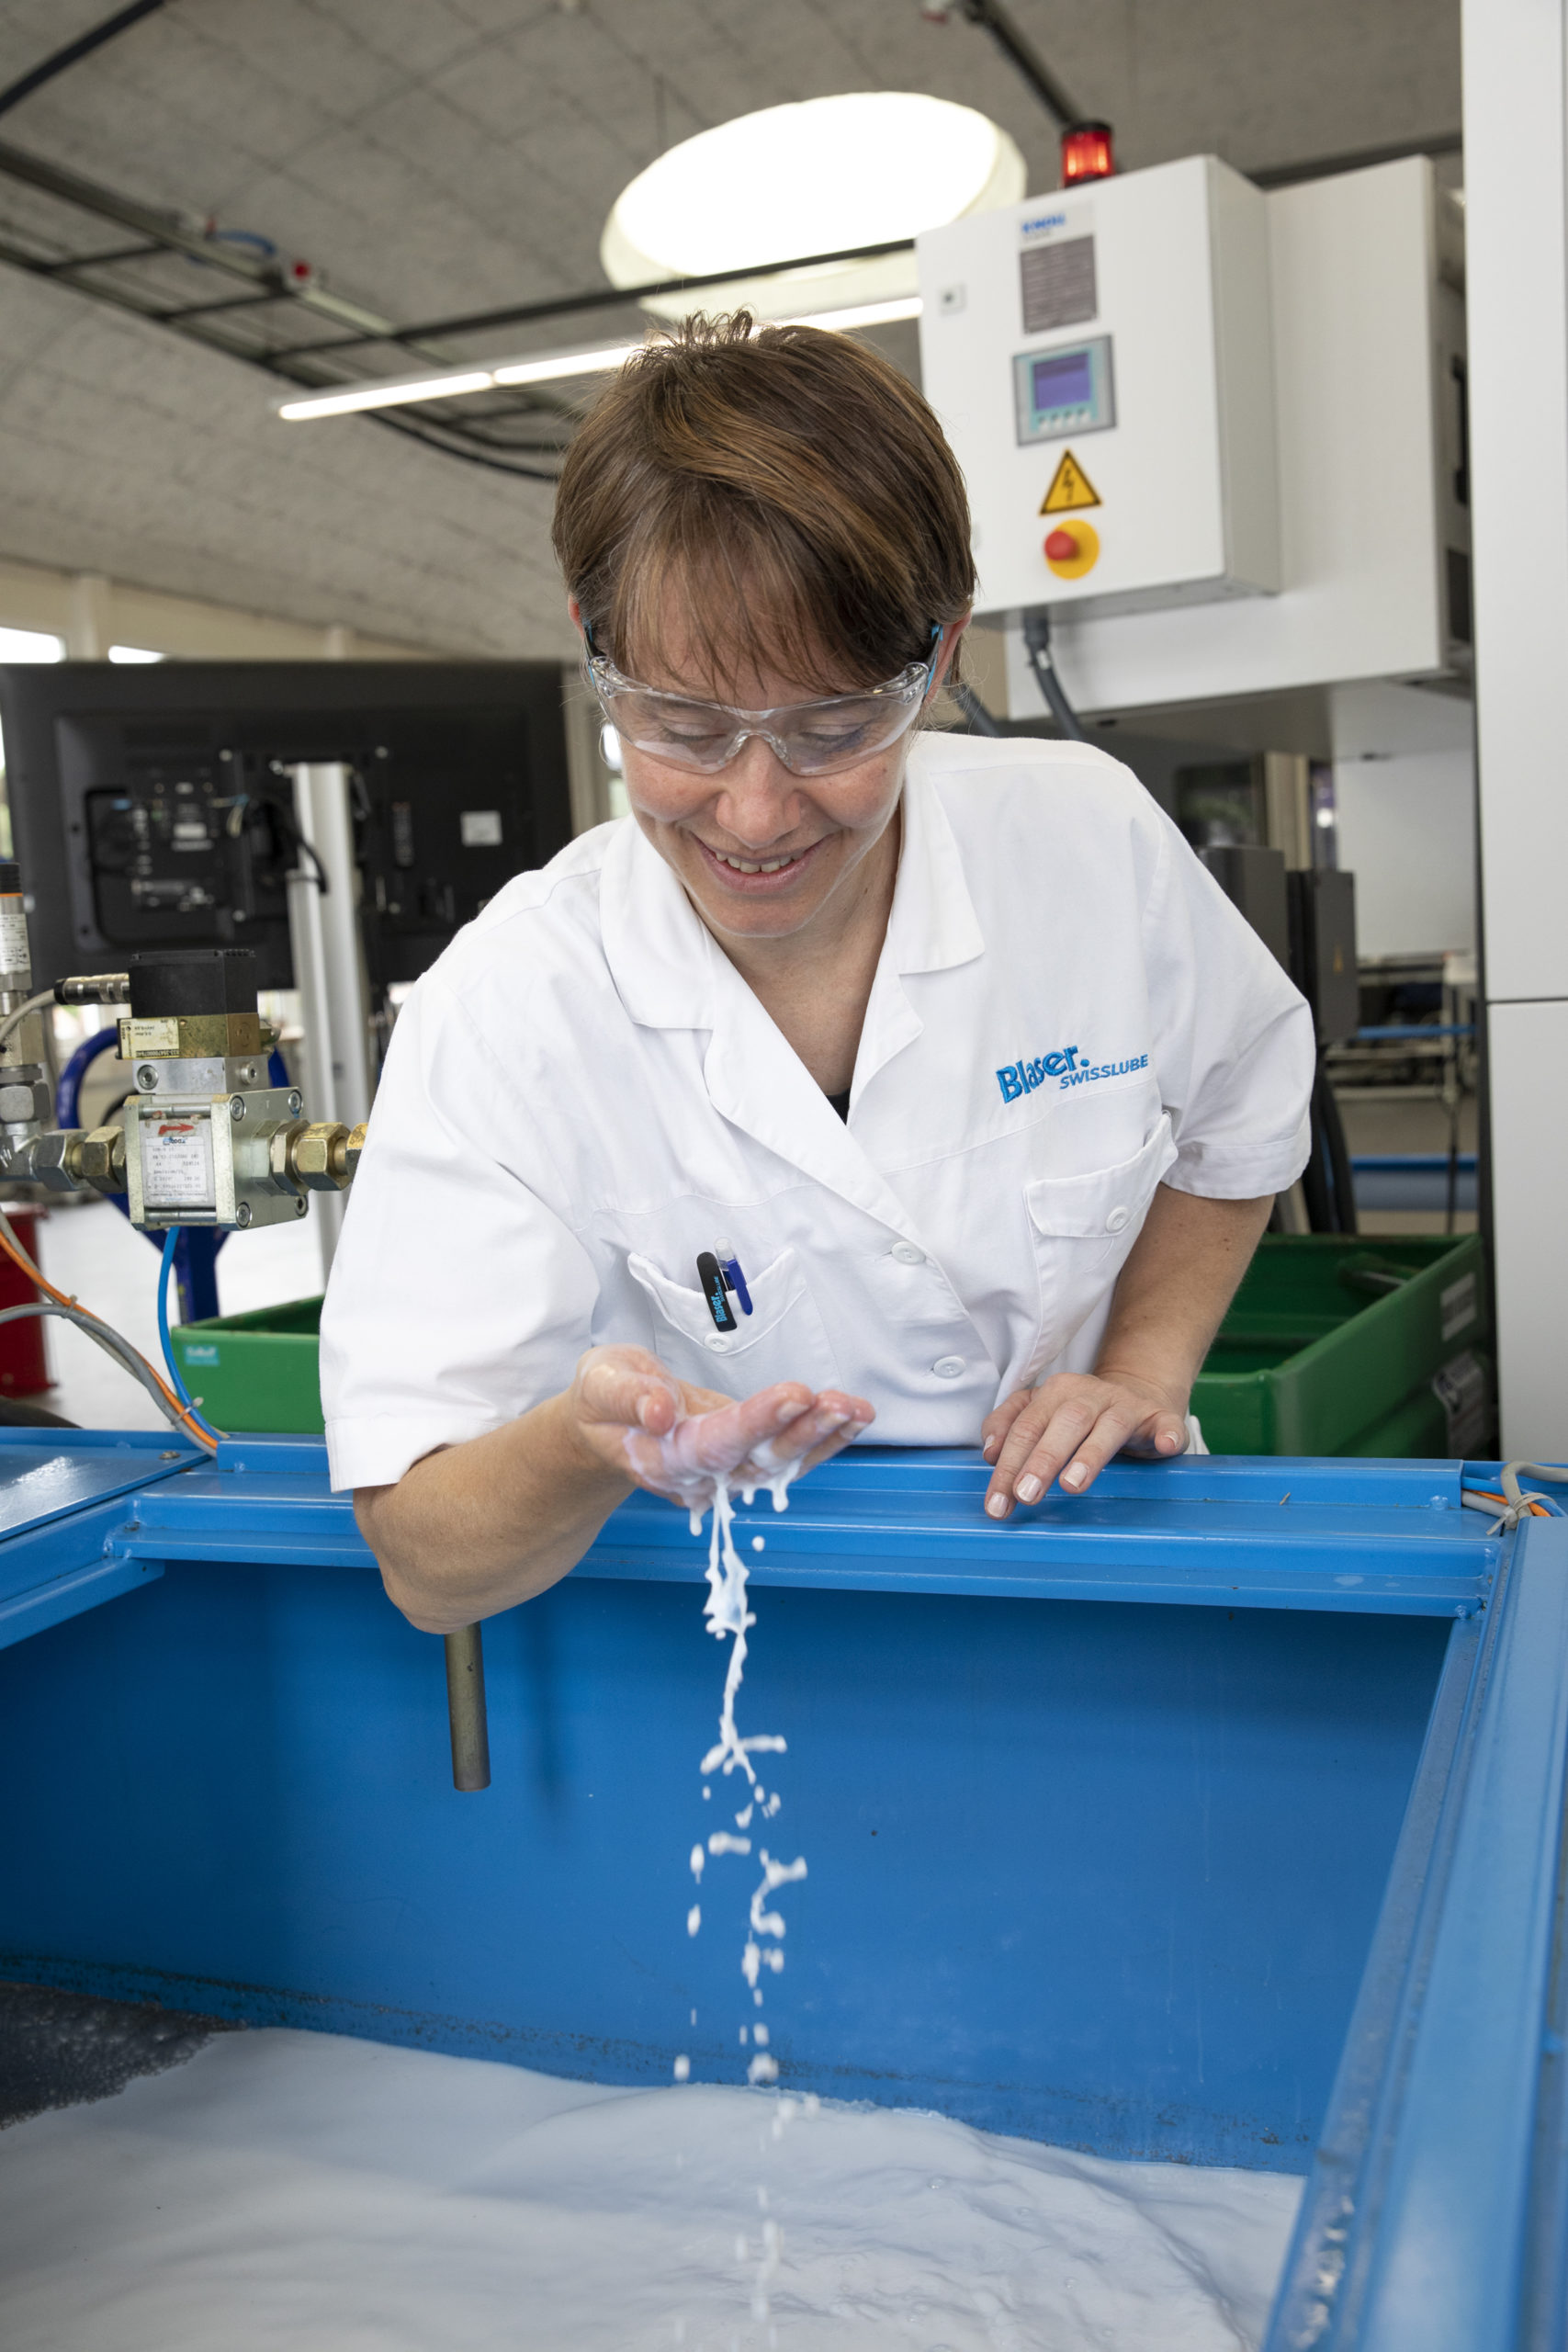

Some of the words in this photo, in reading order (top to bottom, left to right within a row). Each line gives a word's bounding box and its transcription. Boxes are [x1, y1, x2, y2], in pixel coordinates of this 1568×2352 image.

[996, 1046, 1089, 1103] Blaser.
[1059, 1054, 1148, 1090] SWISSLUBE
[711, 1293, 728, 1323] Blaser.
